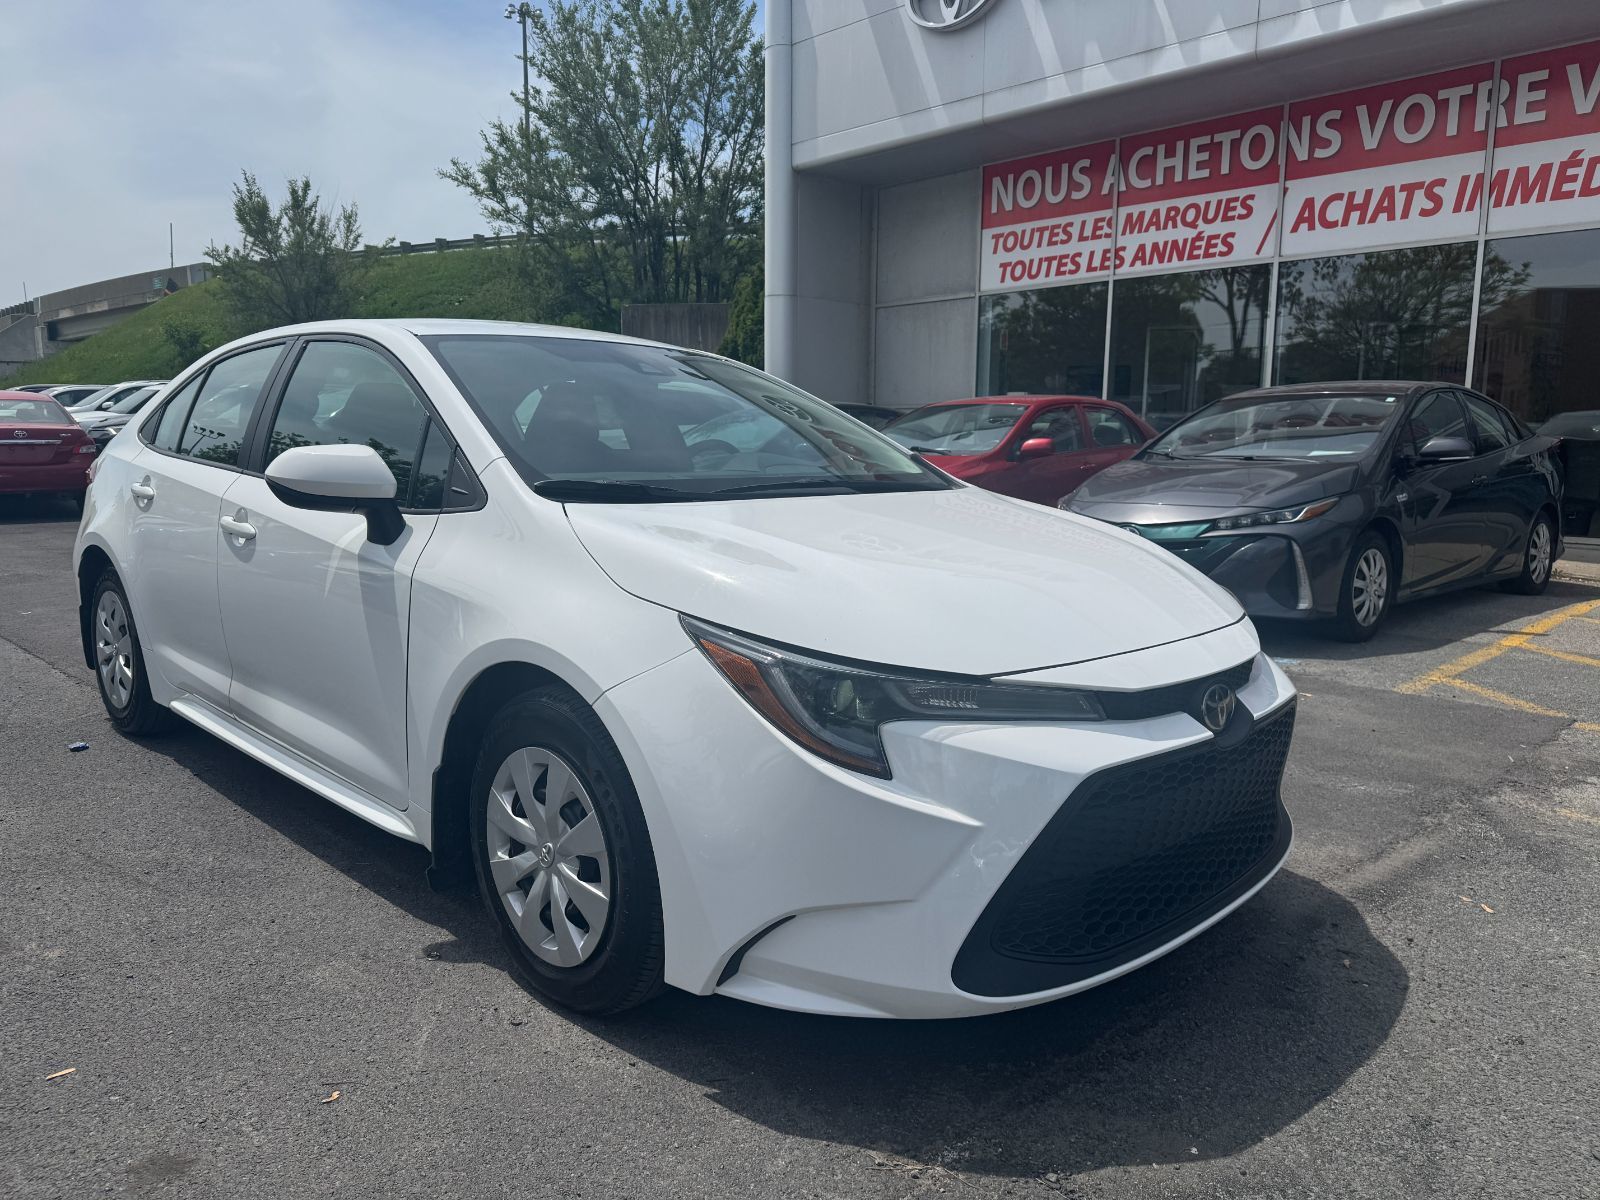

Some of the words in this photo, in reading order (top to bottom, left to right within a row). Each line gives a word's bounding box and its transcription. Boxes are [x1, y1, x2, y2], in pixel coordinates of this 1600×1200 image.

[991, 159, 1091, 214] NOUS
[1101, 110, 1342, 195] ACHETONS
[1356, 69, 1549, 150] VOTRE
[991, 222, 1074, 255] TOUTES
[1121, 194, 1255, 236] MARQUES
[1290, 178, 1447, 233] ACHATS
[999, 252, 1082, 283] TOUTES
[1086, 246, 1127, 273] LES
[1129, 231, 1236, 267] ANNÉES
